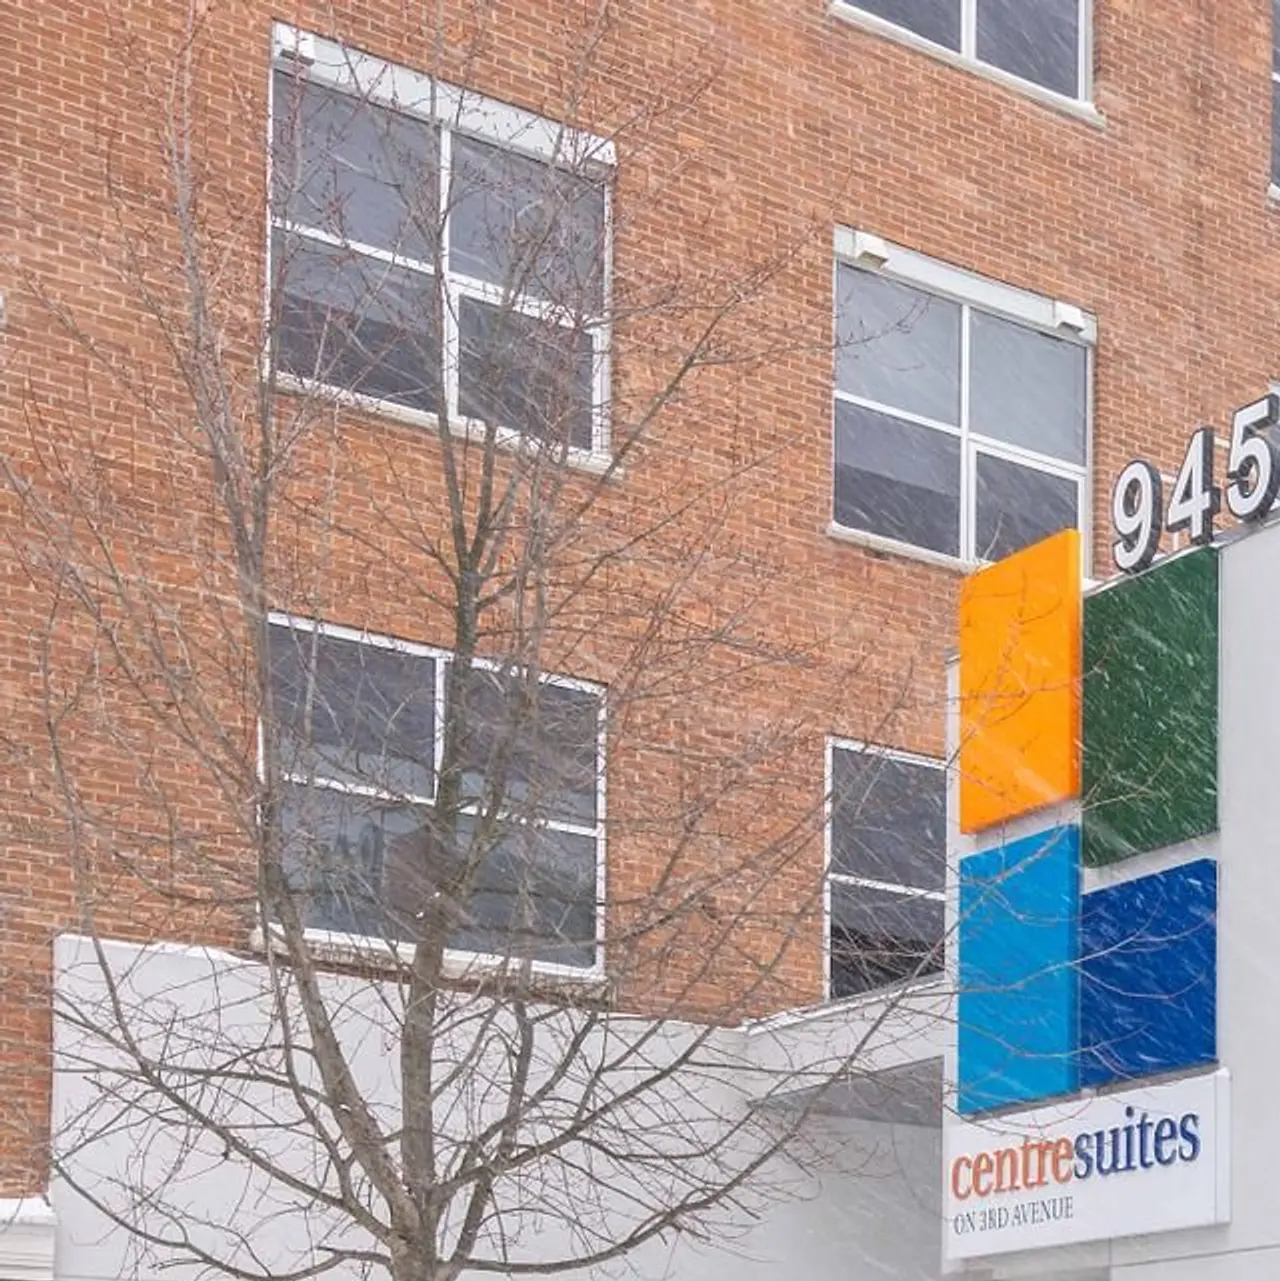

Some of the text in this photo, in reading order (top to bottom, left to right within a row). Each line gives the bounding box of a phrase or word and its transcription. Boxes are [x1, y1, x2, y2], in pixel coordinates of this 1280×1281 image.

[951, 1106, 1201, 1200] centresuites
[953, 1196, 1074, 1236] ON 3RD AVENUE
